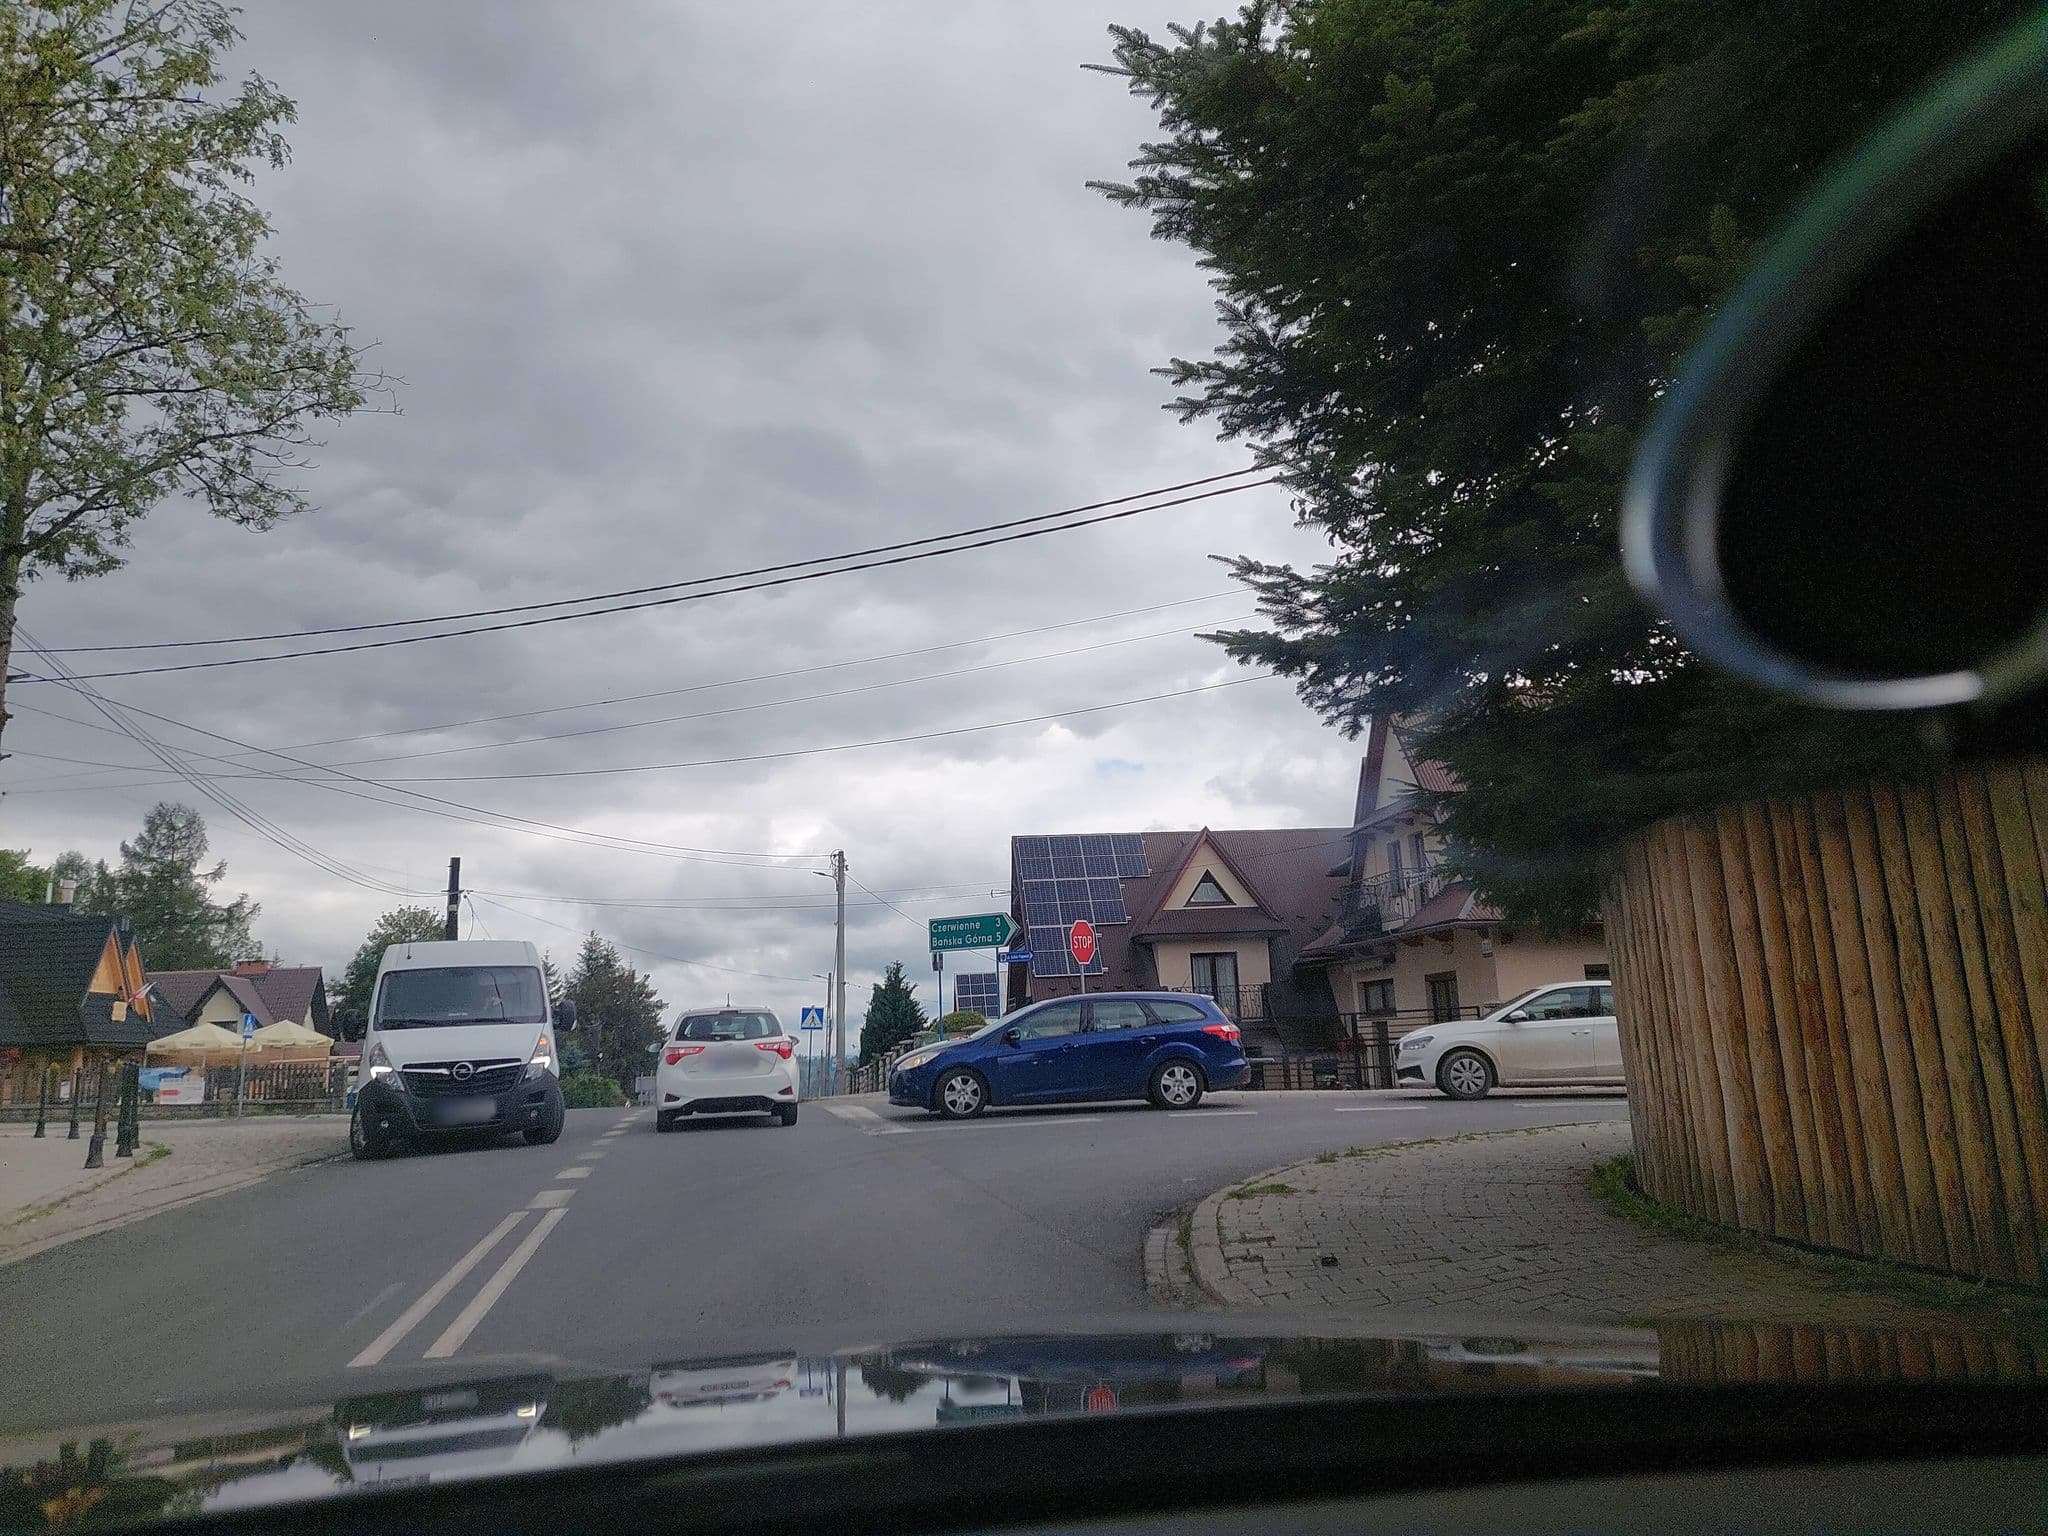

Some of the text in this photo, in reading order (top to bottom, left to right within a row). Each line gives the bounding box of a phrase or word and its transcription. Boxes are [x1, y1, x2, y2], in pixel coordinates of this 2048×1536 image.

[931, 917, 1001, 933] Czerwienne 3
[932, 932, 1002, 947] Bańska Górna 5
[1073, 935, 1093, 949] STOP
